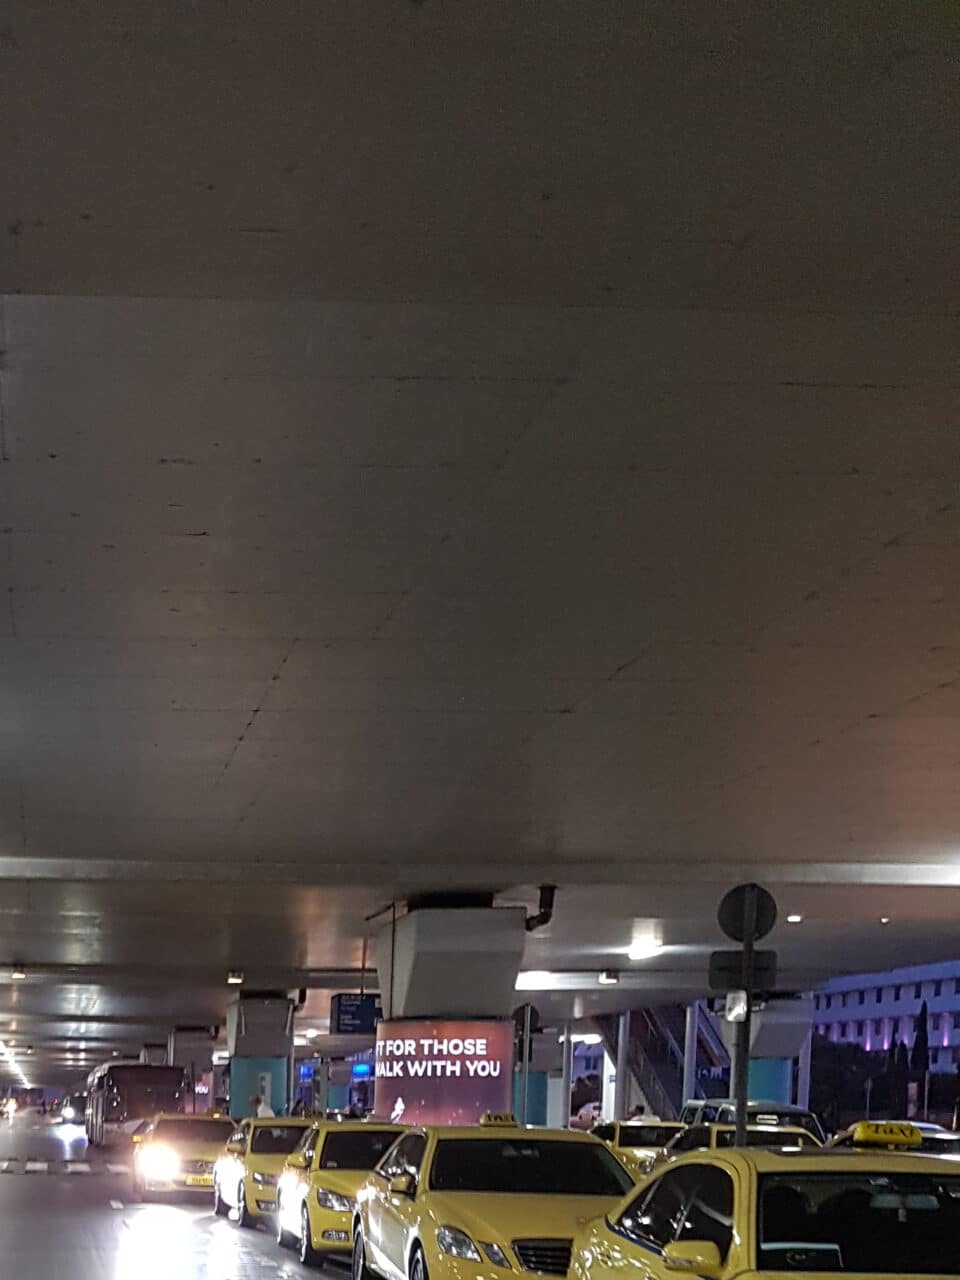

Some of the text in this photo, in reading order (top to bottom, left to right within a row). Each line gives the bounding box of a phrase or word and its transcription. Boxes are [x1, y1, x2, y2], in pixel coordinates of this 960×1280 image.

[386, 1039, 416, 1056] FOR
[420, 1038, 487, 1056] THOSE
[407, 1060, 460, 1077] WITH
[465, 1060, 501, 1077] YOU
